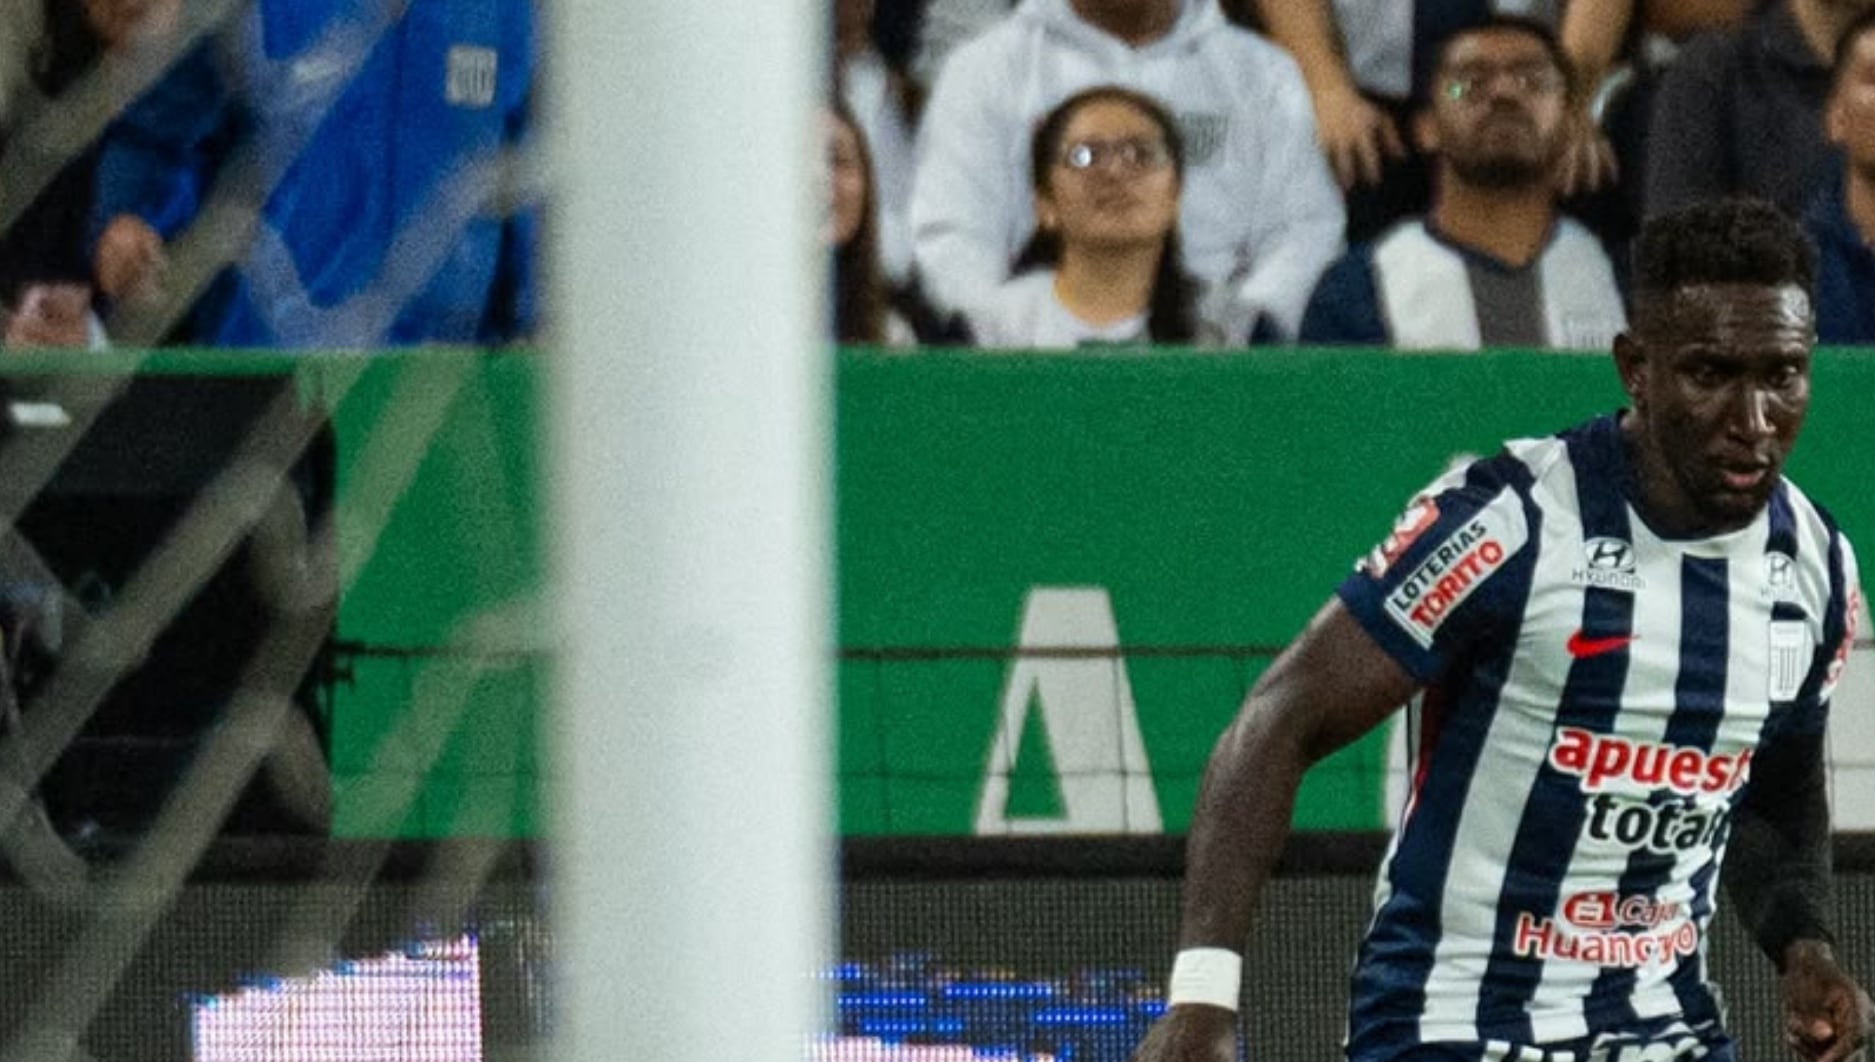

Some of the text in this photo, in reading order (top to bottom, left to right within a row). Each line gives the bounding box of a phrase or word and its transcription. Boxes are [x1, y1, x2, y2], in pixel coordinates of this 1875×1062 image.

[1392, 519, 1488, 611] LOTERIAS
[1408, 539, 1504, 628] TORITO
[1552, 727, 1751, 793] apuest
[1515, 913, 1697, 964] Huancyo
